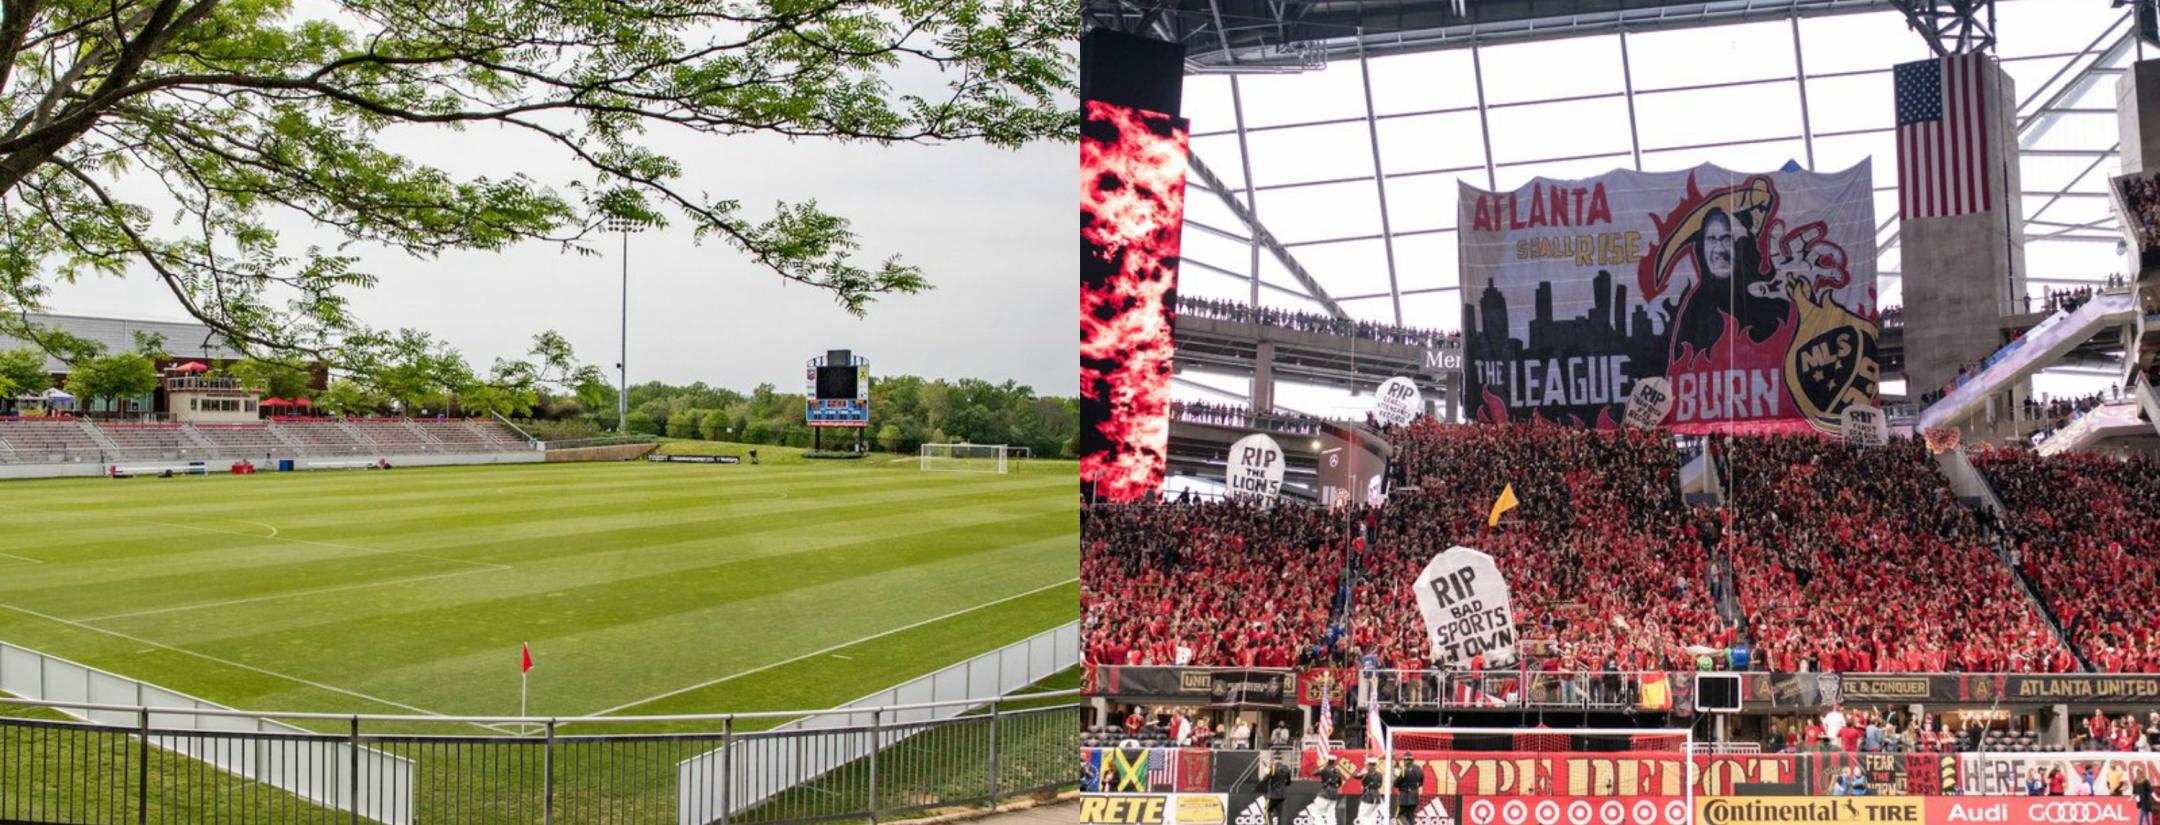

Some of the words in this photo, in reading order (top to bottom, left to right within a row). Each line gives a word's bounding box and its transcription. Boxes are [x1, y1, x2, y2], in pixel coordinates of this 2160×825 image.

[1473, 182, 1612, 231] ATLANTA
[1517, 237, 1575, 260] SHALL
[1575, 231, 1642, 267] RISE
[1801, 333, 1852, 372] MLS
[1387, 382, 1414, 400] RIP
[1474, 360, 1504, 385] THE
[1510, 355, 1631, 407] LEAGUE
[1640, 384, 1665, 405] RIP
[1676, 368, 1779, 421] BURN
[1850, 411, 1876, 424] RIP
[1241, 446, 1276, 468] RIP
[1246, 468, 1265, 478] THE
[1430, 565, 1476, 608] RIP
[1450, 600, 1482, 619] BAD
[1437, 606, 1507, 645] SPORTS
[1445, 628, 1513, 662] TOWN
[1871, 682, 1926, 693] CONQUER
[2019, 679, 2092, 696] ATLANTA
[2097, 679, 2158, 696] UNITED
[1866, 754, 1895, 771] FEAR
[1872, 771, 1889, 782] THE
[1964, 760, 2025, 794] HERE
[1703, 799, 1838, 825] Continental
[1865, 804, 1918, 821] TIRE
[1948, 803, 2007, 821] Audi
